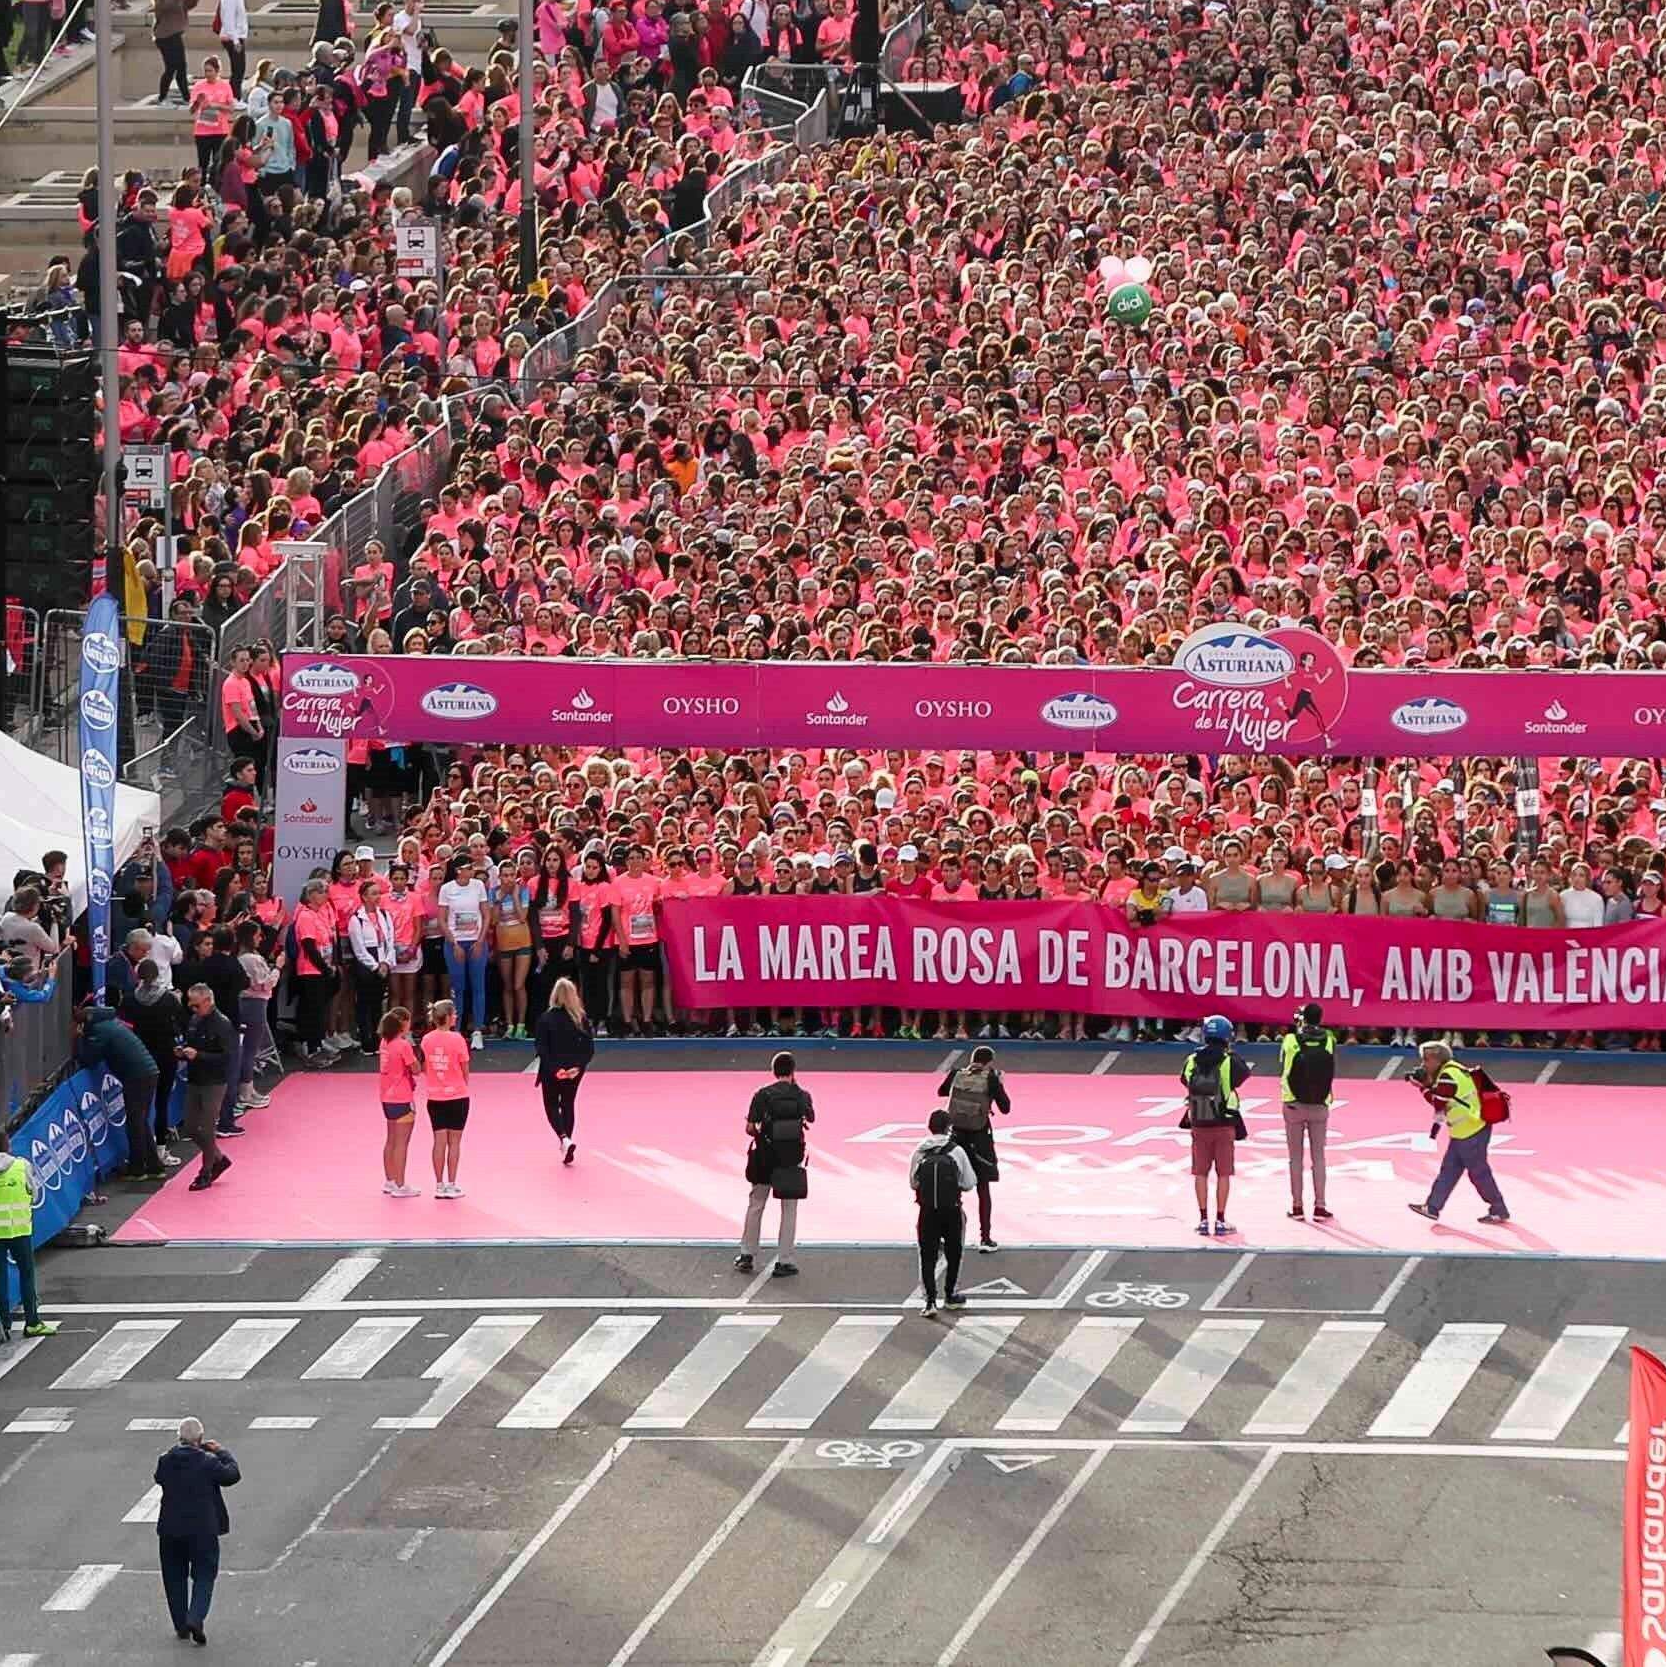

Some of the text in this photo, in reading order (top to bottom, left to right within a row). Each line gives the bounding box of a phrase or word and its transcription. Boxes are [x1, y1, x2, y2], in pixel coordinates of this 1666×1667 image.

[1193, 653, 1285, 673] ASTURIANA
[294, 674, 357, 688] ASTURIANA
[283, 692, 343, 713] Carrera
[425, 693, 493, 712] ASTURIANA
[1173, 682, 1264, 710] Carrera
[663, 697, 739, 715] OYSHO
[915, 700, 992, 719] OYSHO
[1045, 704, 1113, 722] ASTURIANA
[297, 708, 362, 737] de la Mujer
[552, 709, 614, 723] Santander
[806, 712, 868, 726] Santander
[1397, 711, 1462, 726] ASTURIANA
[1195, 709, 1298, 752] de la Mujer
[1525, 721, 1587, 734] Santander
[286, 758, 339, 770] ASTURIANA
[283, 812, 334, 824] Santander
[277, 845, 337, 861] OYSHO
[693, 925, 744, 982] LA
[758, 924, 897, 982] MAREA
[913, 927, 1022, 984] ROSA
[1039, 930, 1090, 986] DE
[1104, 932, 1364, 1007] BARCELONA,
[1380, 945, 1474, 1002] AMB
